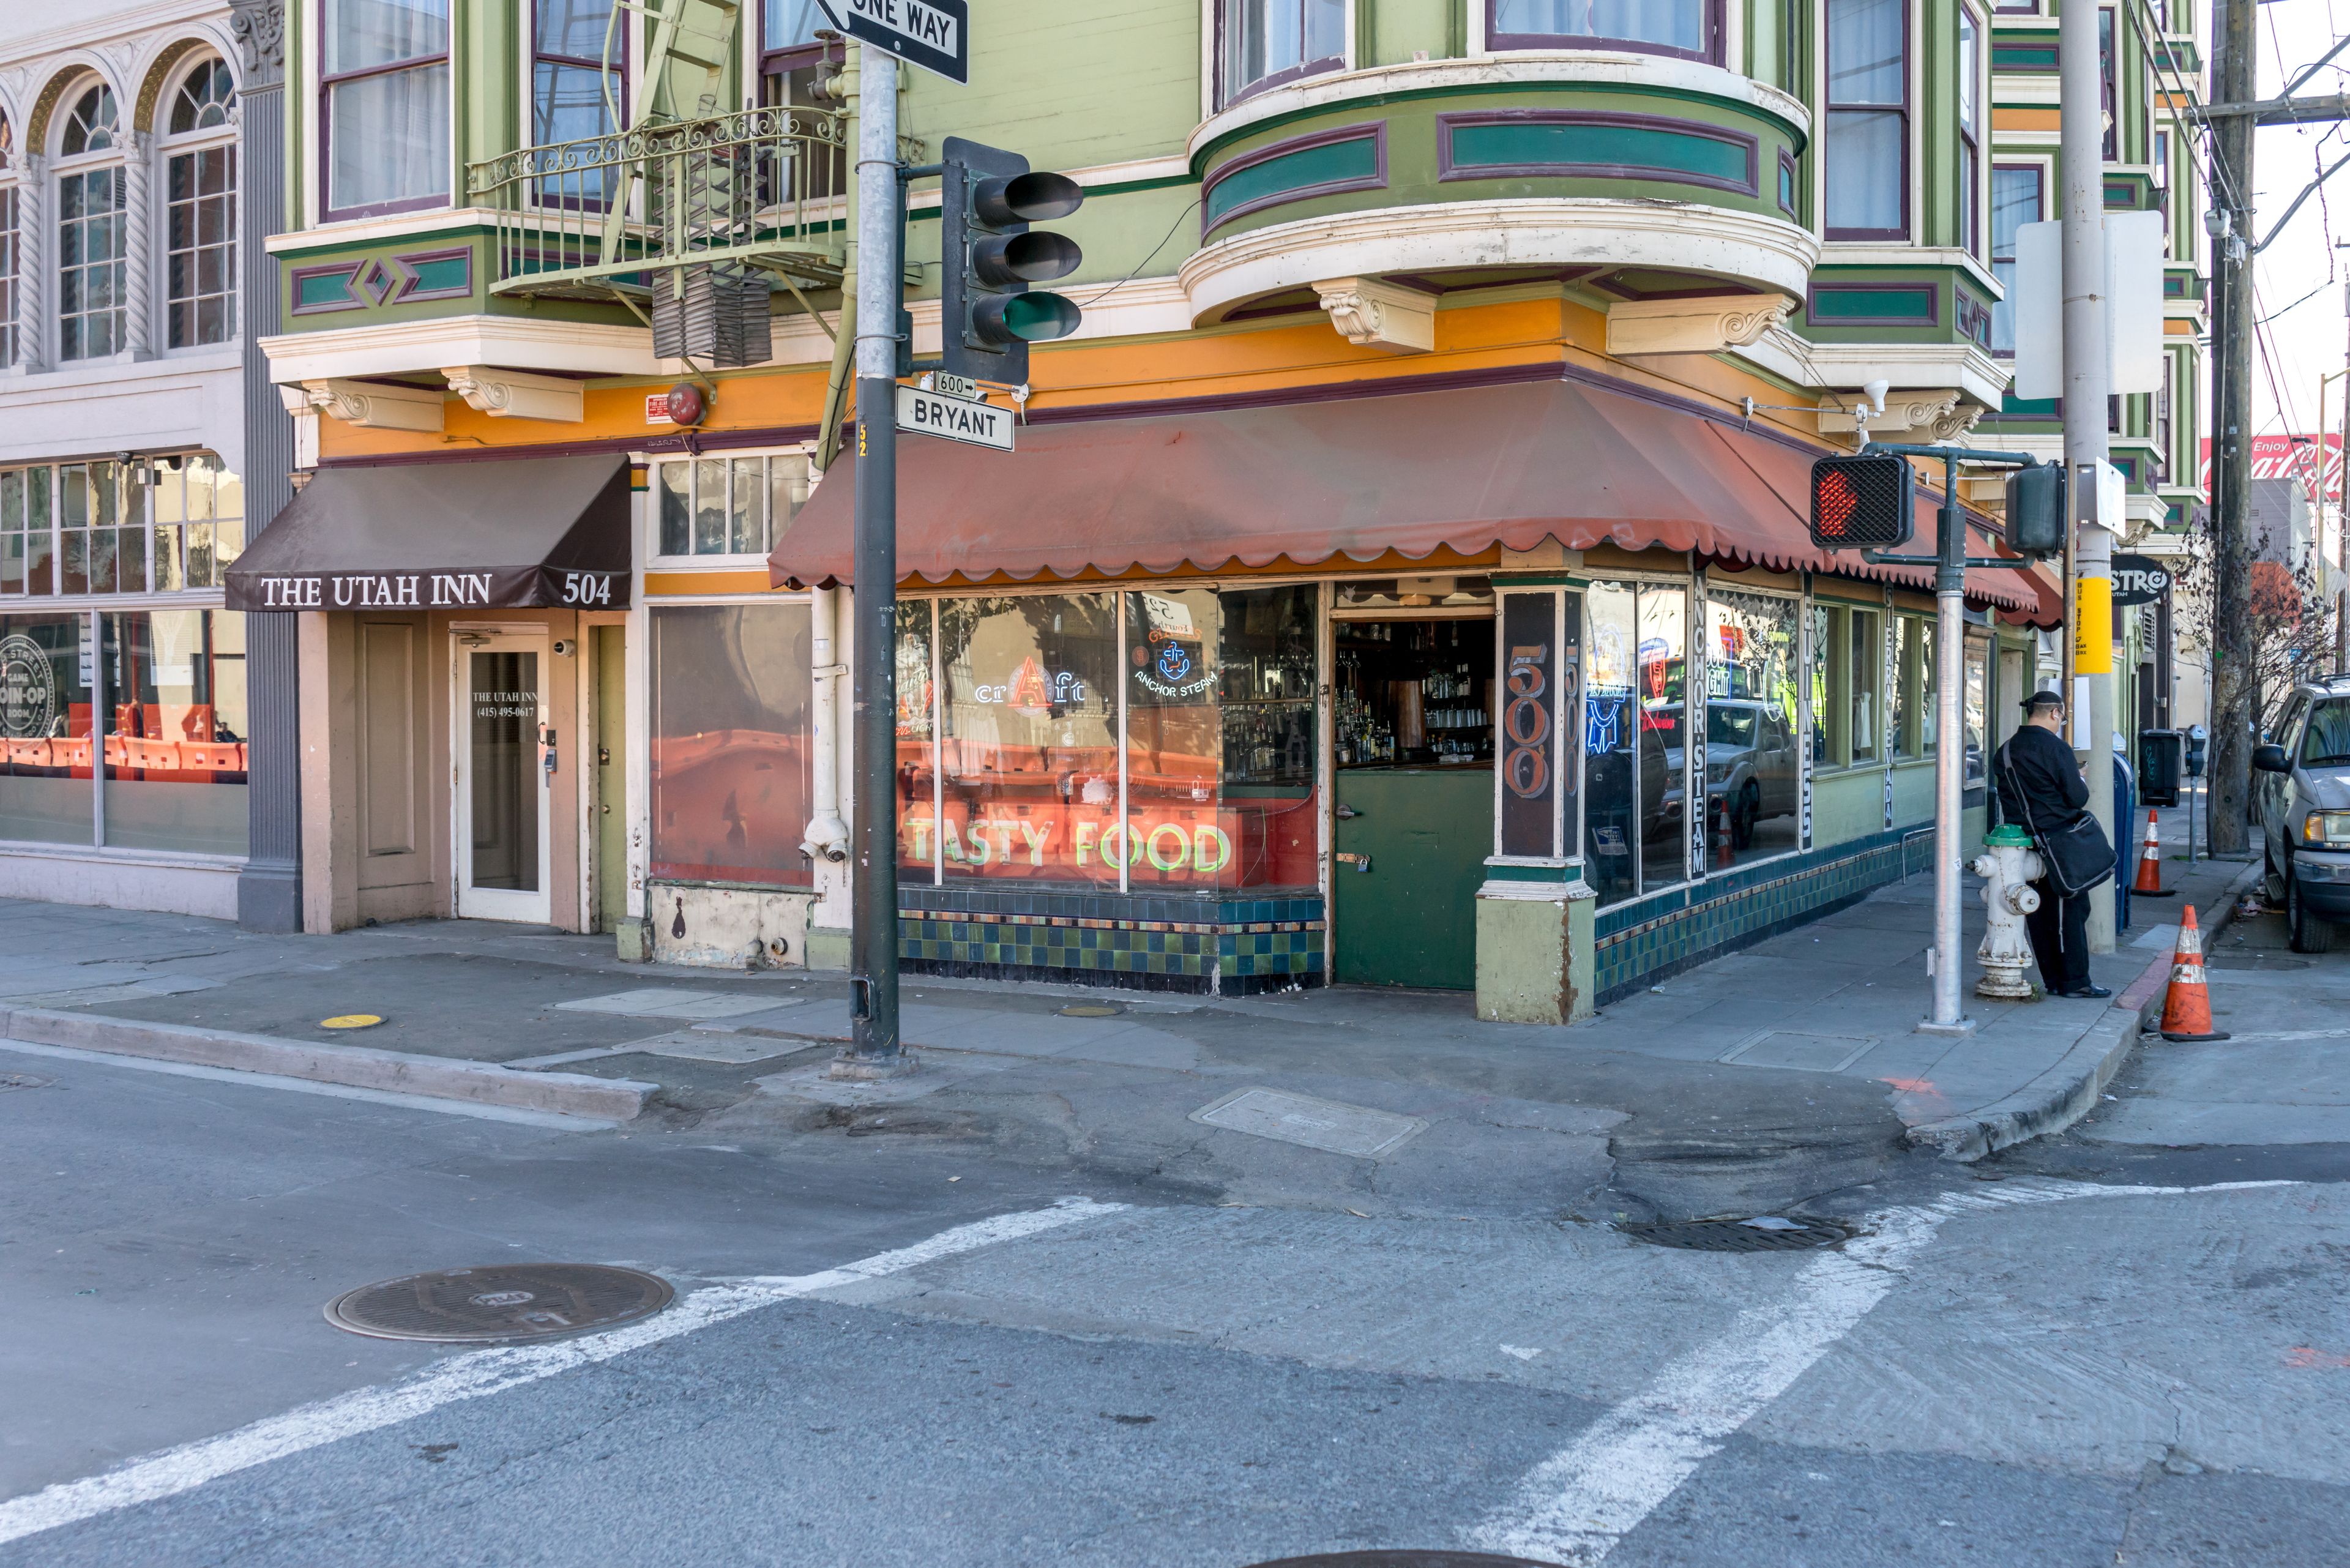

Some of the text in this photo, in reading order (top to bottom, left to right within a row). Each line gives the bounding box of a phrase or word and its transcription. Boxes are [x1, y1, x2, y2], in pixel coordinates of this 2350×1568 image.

[907, 1, 950, 48] WAY
[941, 375, 963, 393] 600
[915, 398, 996, 438] BRYANT
[859, 424, 867, 457] 52
[2253, 441, 2288, 452] Enjoy
[261, 573, 493, 607] THE UTAH INN
[562, 573, 611, 605] 504
[7, 673, 29, 682] GAME
[10, 649, 43, 679] STREET
[0, 687, 47, 704] OIN-OP
[473, 692, 538, 702] THE UTAH INN
[1135, 671, 1218, 698] ANCHOR STEAM
[7, 709, 29, 718] ROOM
[477, 707, 534, 719] (415) 495-0617
[911, 723, 932, 733] LIGH
[1504, 643, 1551, 798] 500
[1564, 643, 1579, 796] 500
[1692, 576, 1705, 873] ANCHOR STEAM
[905, 818, 1232, 872] TASTY FOOD
